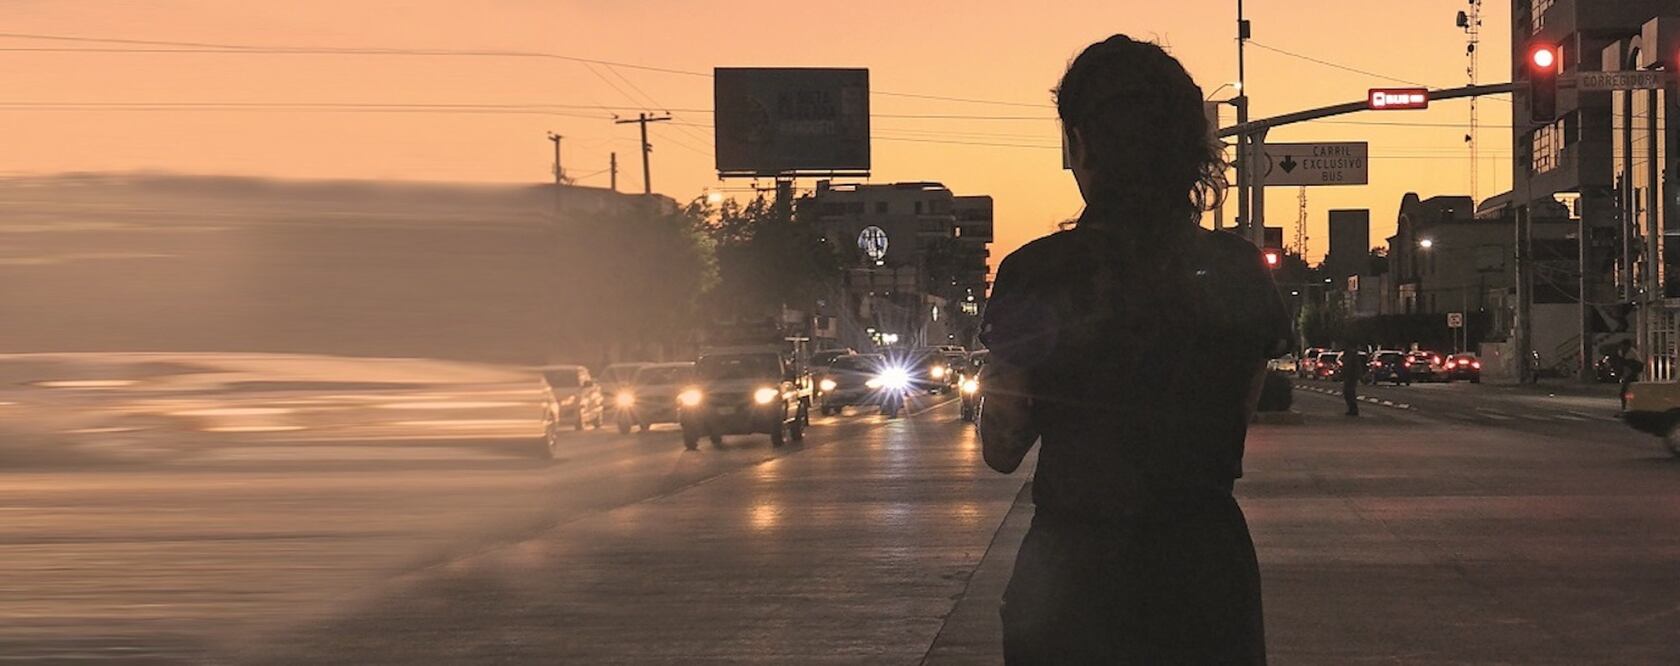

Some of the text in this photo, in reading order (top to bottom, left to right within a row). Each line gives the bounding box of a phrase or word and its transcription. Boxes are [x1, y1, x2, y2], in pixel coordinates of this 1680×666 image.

[1583, 74, 1657, 87] CORREGIDORA
[1313, 146, 1351, 157] CARRIL
[1303, 159, 1362, 169] EXCLUSIVO
[1322, 171, 1343, 181] BUS
